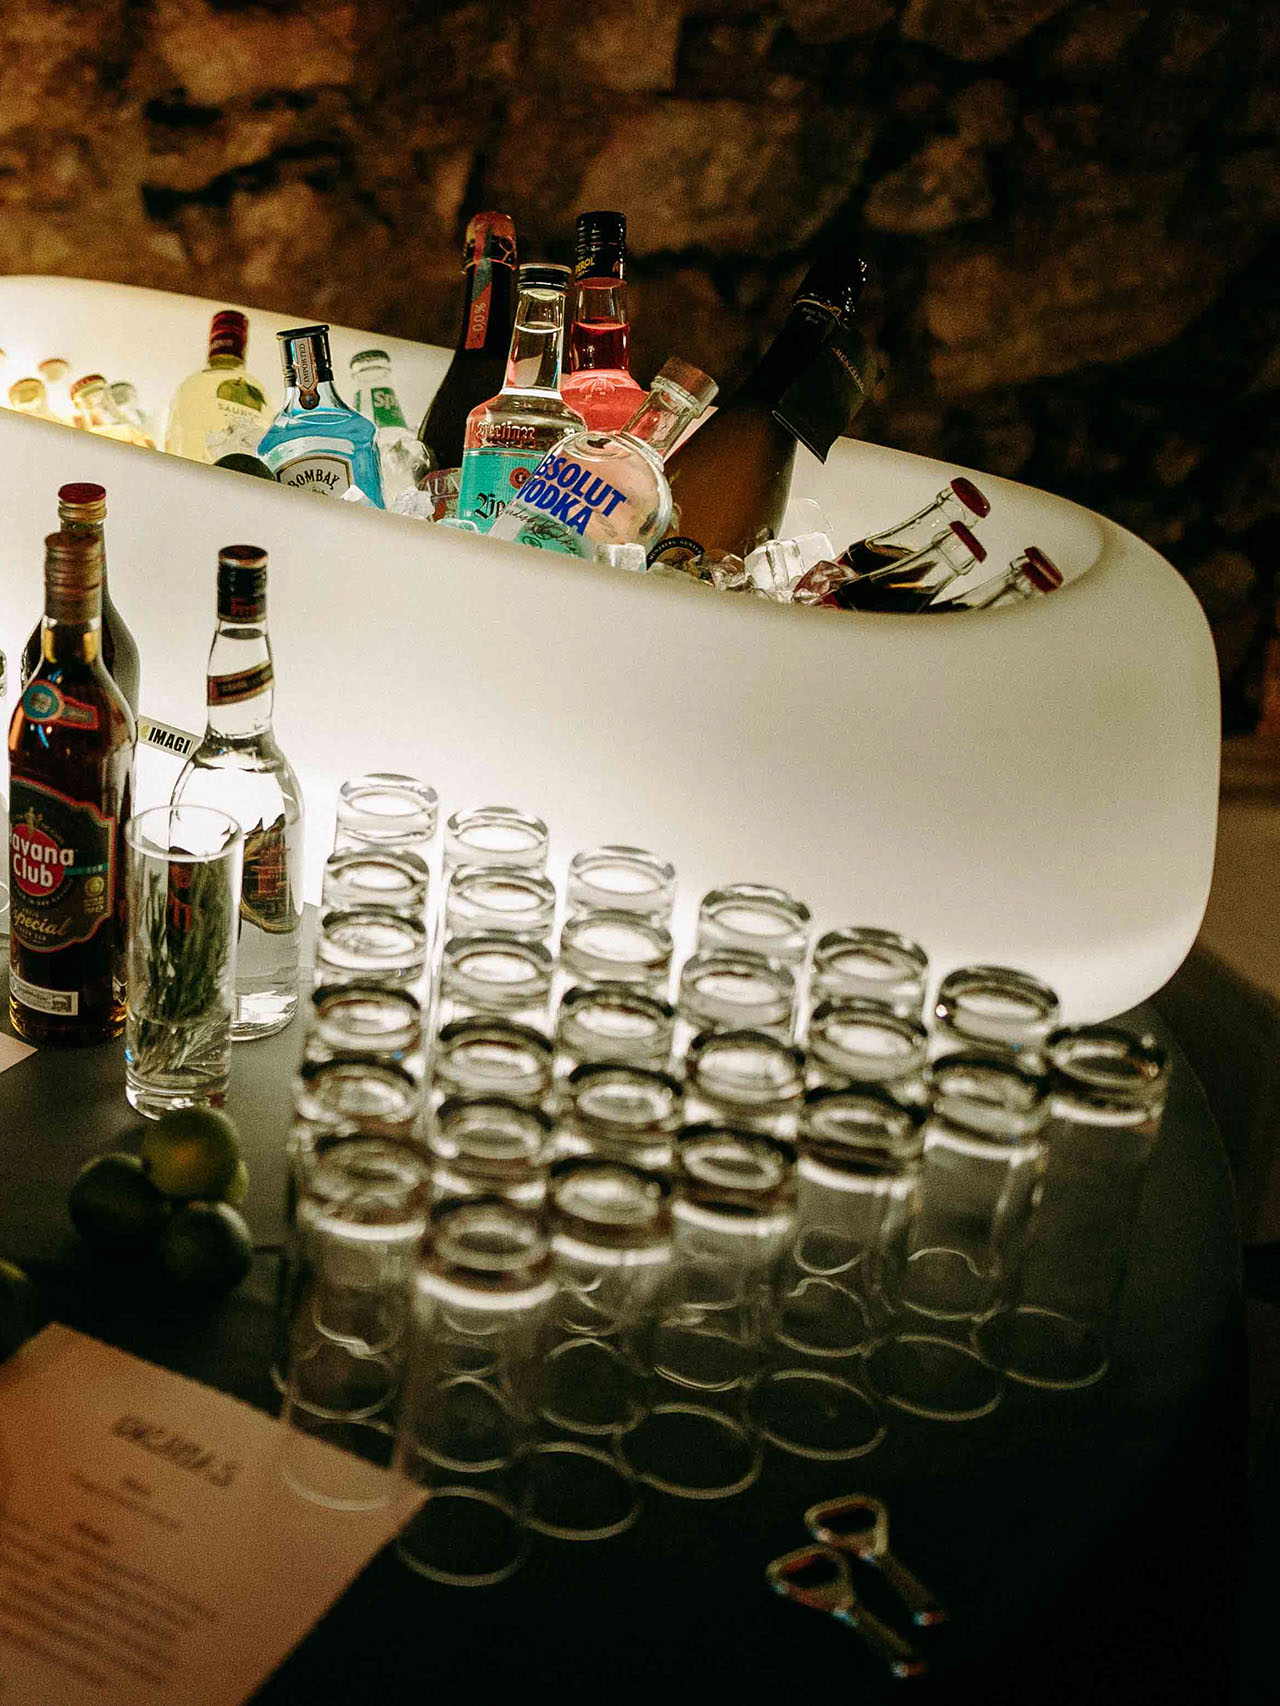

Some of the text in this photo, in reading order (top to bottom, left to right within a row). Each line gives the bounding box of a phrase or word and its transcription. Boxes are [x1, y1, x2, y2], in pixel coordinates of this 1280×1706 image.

[574, 256, 596, 275] PEROL
[299, 342, 311, 384] IMPORTED
[287, 468, 340, 490] BOMBAY
[537, 454, 628, 517] BSOLUT
[516, 478, 594, 536] VODKA
[147, 726, 194, 755] IMAGI
[10, 833, 75, 867] avana
[13, 855, 54, 888] Club
[12, 912, 72, 936] pecial
